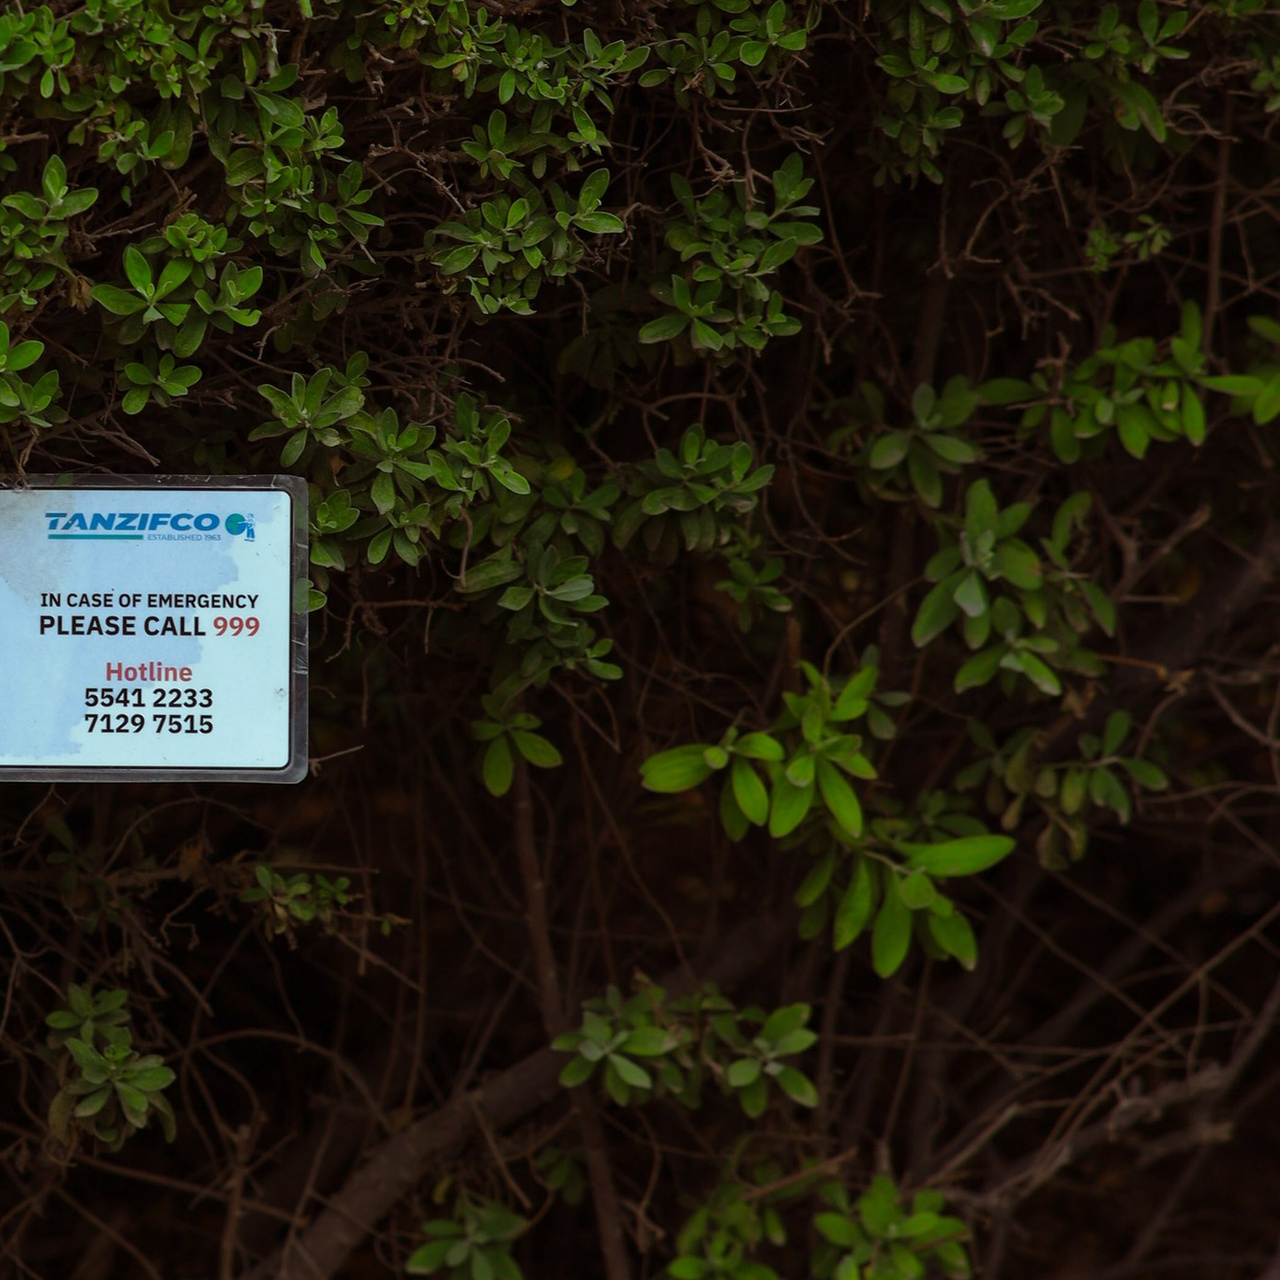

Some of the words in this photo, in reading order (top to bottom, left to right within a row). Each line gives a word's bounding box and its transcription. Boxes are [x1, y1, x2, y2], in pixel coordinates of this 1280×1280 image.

[45, 513, 220, 531] TANZIFCO
[41, 593, 60, 607] IN
[67, 594, 113, 607] CASE
[119, 594, 142, 607] OF
[148, 594, 258, 608] EMERGENCY
[40, 616, 135, 635] PLEASE
[144, 616, 206, 636] CALL
[214, 617, 259, 636] 999
[107, 662, 192, 681] Hotline
[85, 688, 145, 707] 5541
[153, 689, 212, 707] 2233
[85, 714, 144, 733] 7129
[153, 715, 213, 733] 7515
